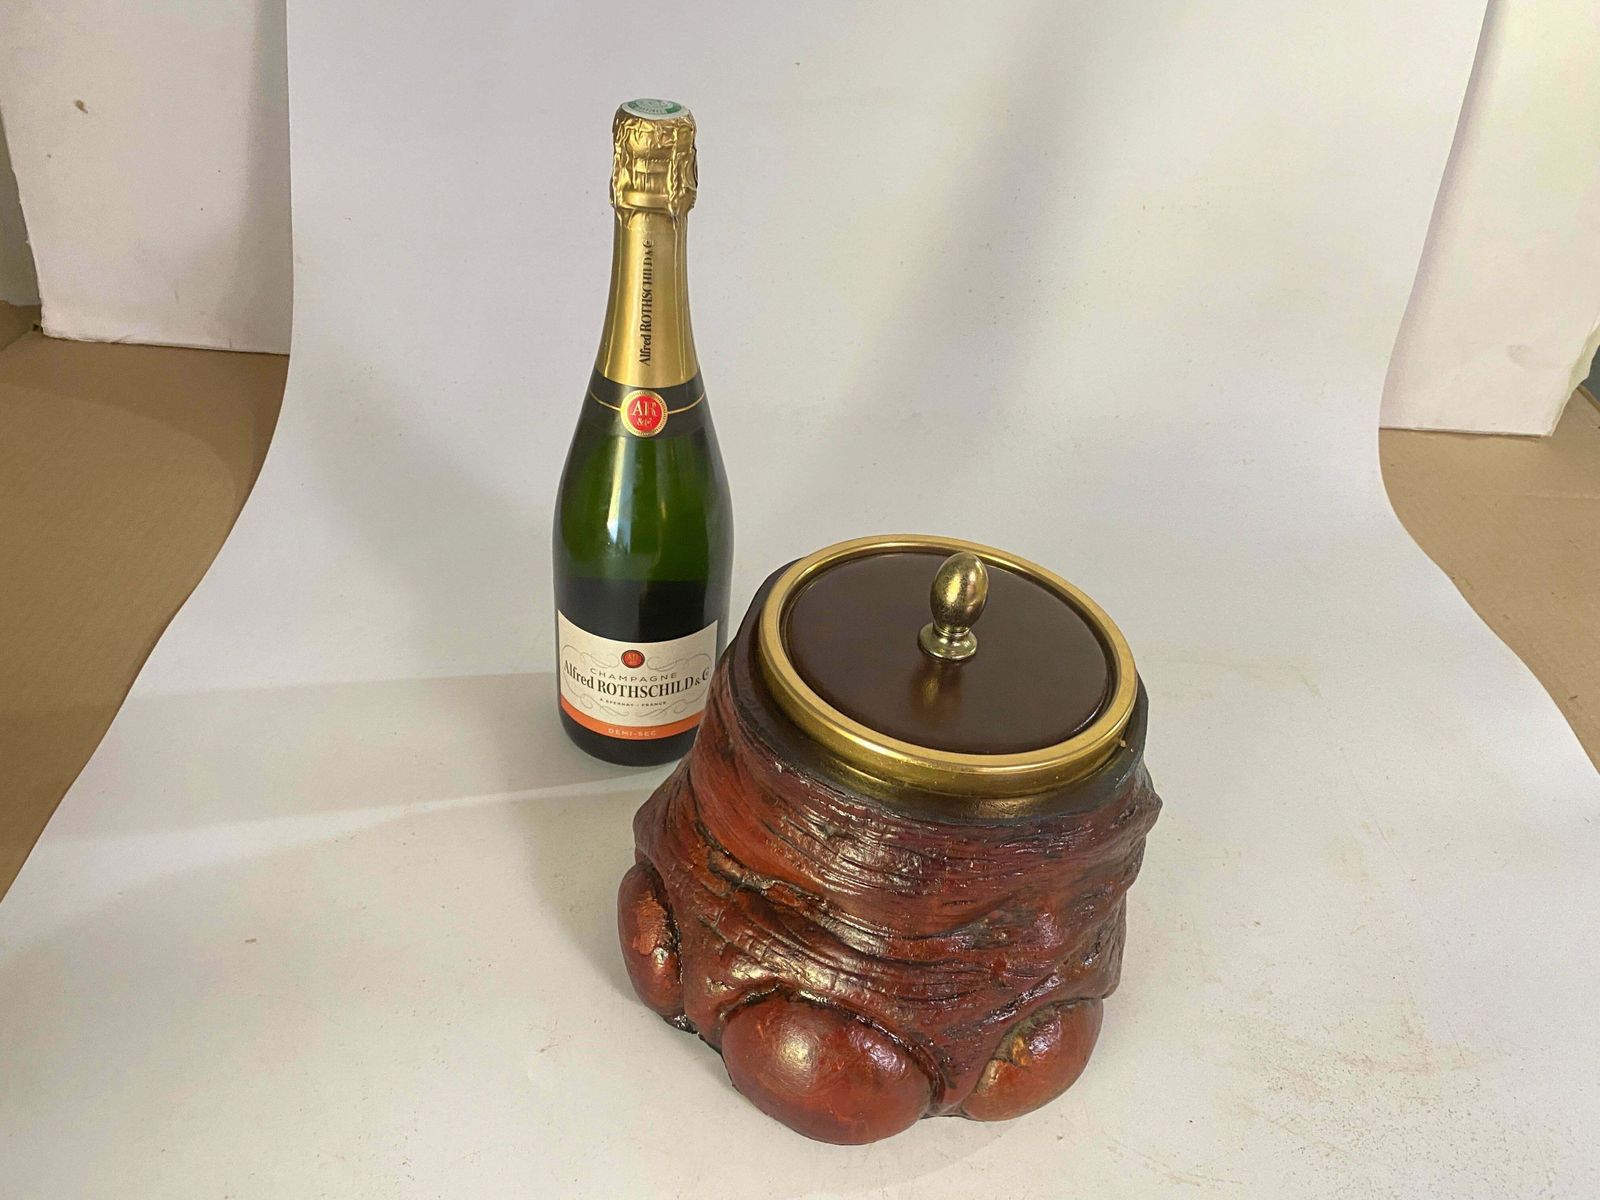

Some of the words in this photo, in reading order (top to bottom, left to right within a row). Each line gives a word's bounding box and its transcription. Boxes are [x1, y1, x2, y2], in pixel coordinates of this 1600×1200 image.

[640, 257, 653, 332] ROTHSCHILD
[639, 334, 652, 367] Alfred
[631, 400, 657, 417] AR
[564, 660, 594, 689] Alfred
[598, 676, 694, 699] ROTHSCHILD
[590, 667, 678, 683] CHAMPAGNE
[607, 728, 657, 737] DEMI-SEC
